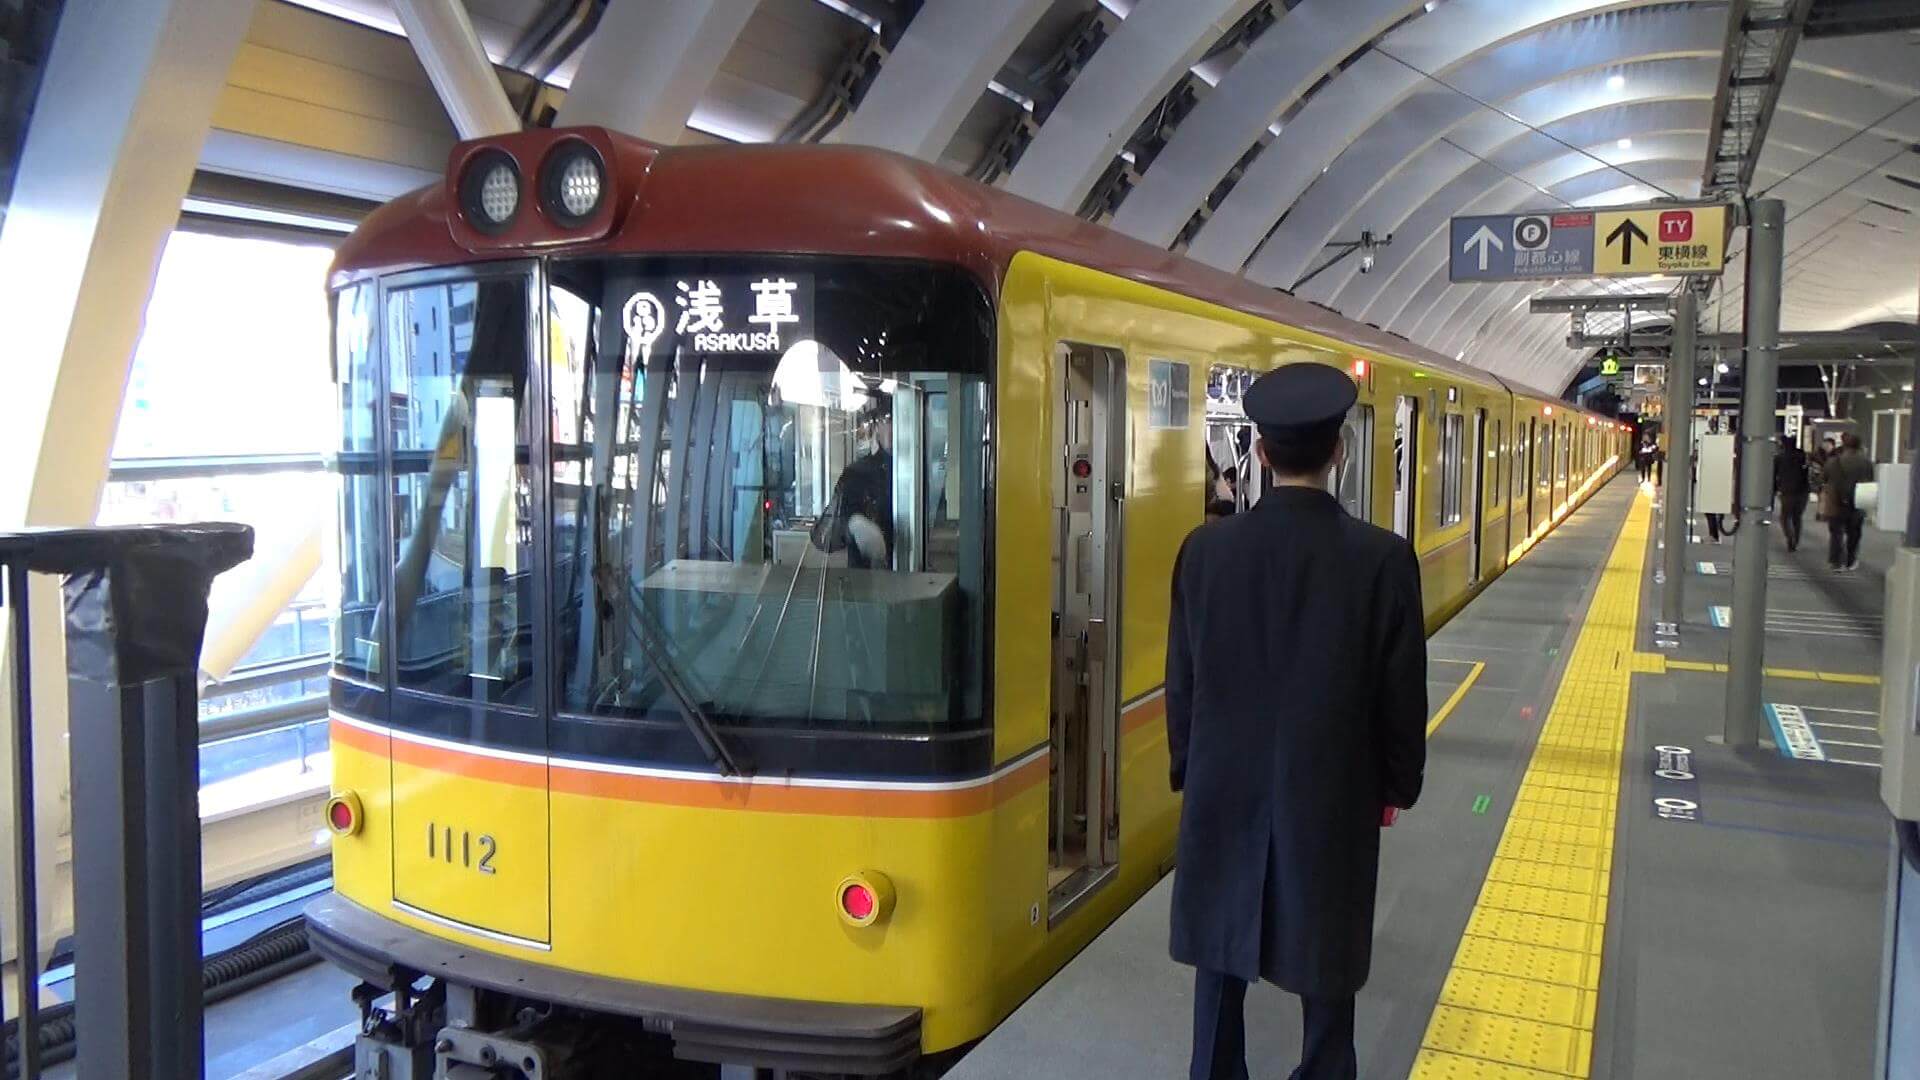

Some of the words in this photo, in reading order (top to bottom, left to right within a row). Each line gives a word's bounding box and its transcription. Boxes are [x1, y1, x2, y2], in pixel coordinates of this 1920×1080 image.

[1527, 227, 1536, 239] F
[1664, 220, 1688, 234] TY
[1659, 245, 1708, 260] 東横線
[675, 278, 799, 335] 浅草
[695, 333, 779, 351] ASAKUSA
[429, 822, 496, 874] 1112
